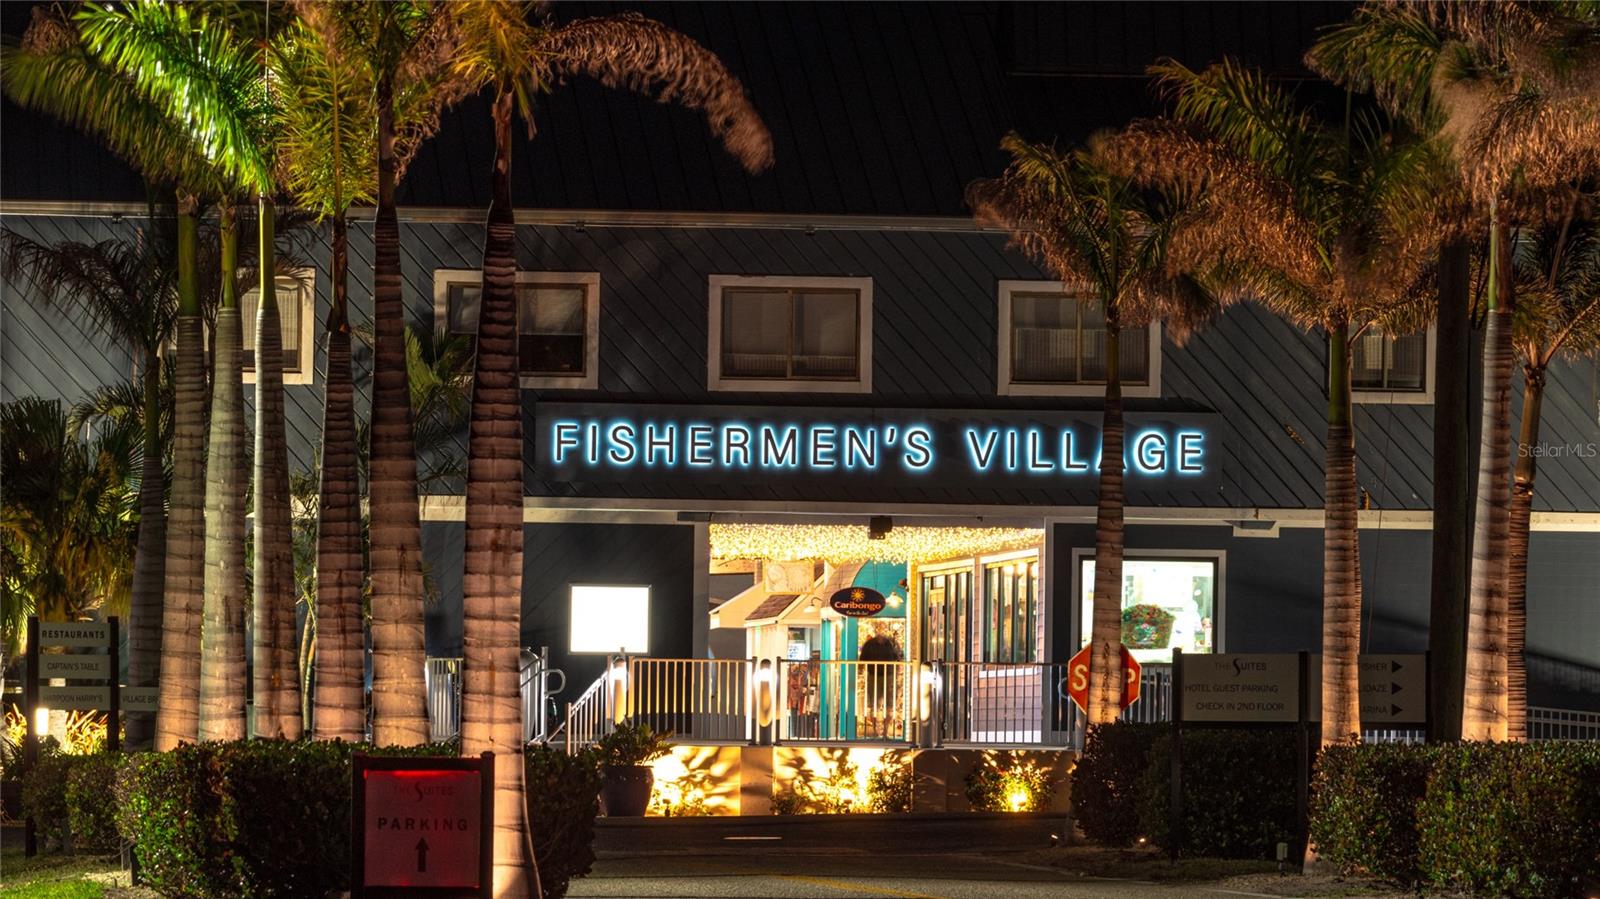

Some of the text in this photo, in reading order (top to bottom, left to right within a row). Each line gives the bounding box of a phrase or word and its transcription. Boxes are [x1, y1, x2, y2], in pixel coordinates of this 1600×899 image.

[555, 423, 933, 468] FISHERMEN'S
[834, 601, 882, 611] Caribongo
[42, 630, 105, 639] RESTAURANTS
[47, 663, 100, 671] CAPTAIN'S TABLE
[1214, 658, 1267, 677] THE SUITES
[1072, 664, 1137, 692] SP
[1185, 684, 1279, 693] HOTEL GUEST PARKING
[75, 694, 104, 703] HARRY'S
[122, 695, 146, 704] VILLAGE
[1196, 702, 1284, 711] CHECK IN 2ND FLOOR
[414, 780, 455, 802] SUITES
[378, 817, 469, 831] PARKING
